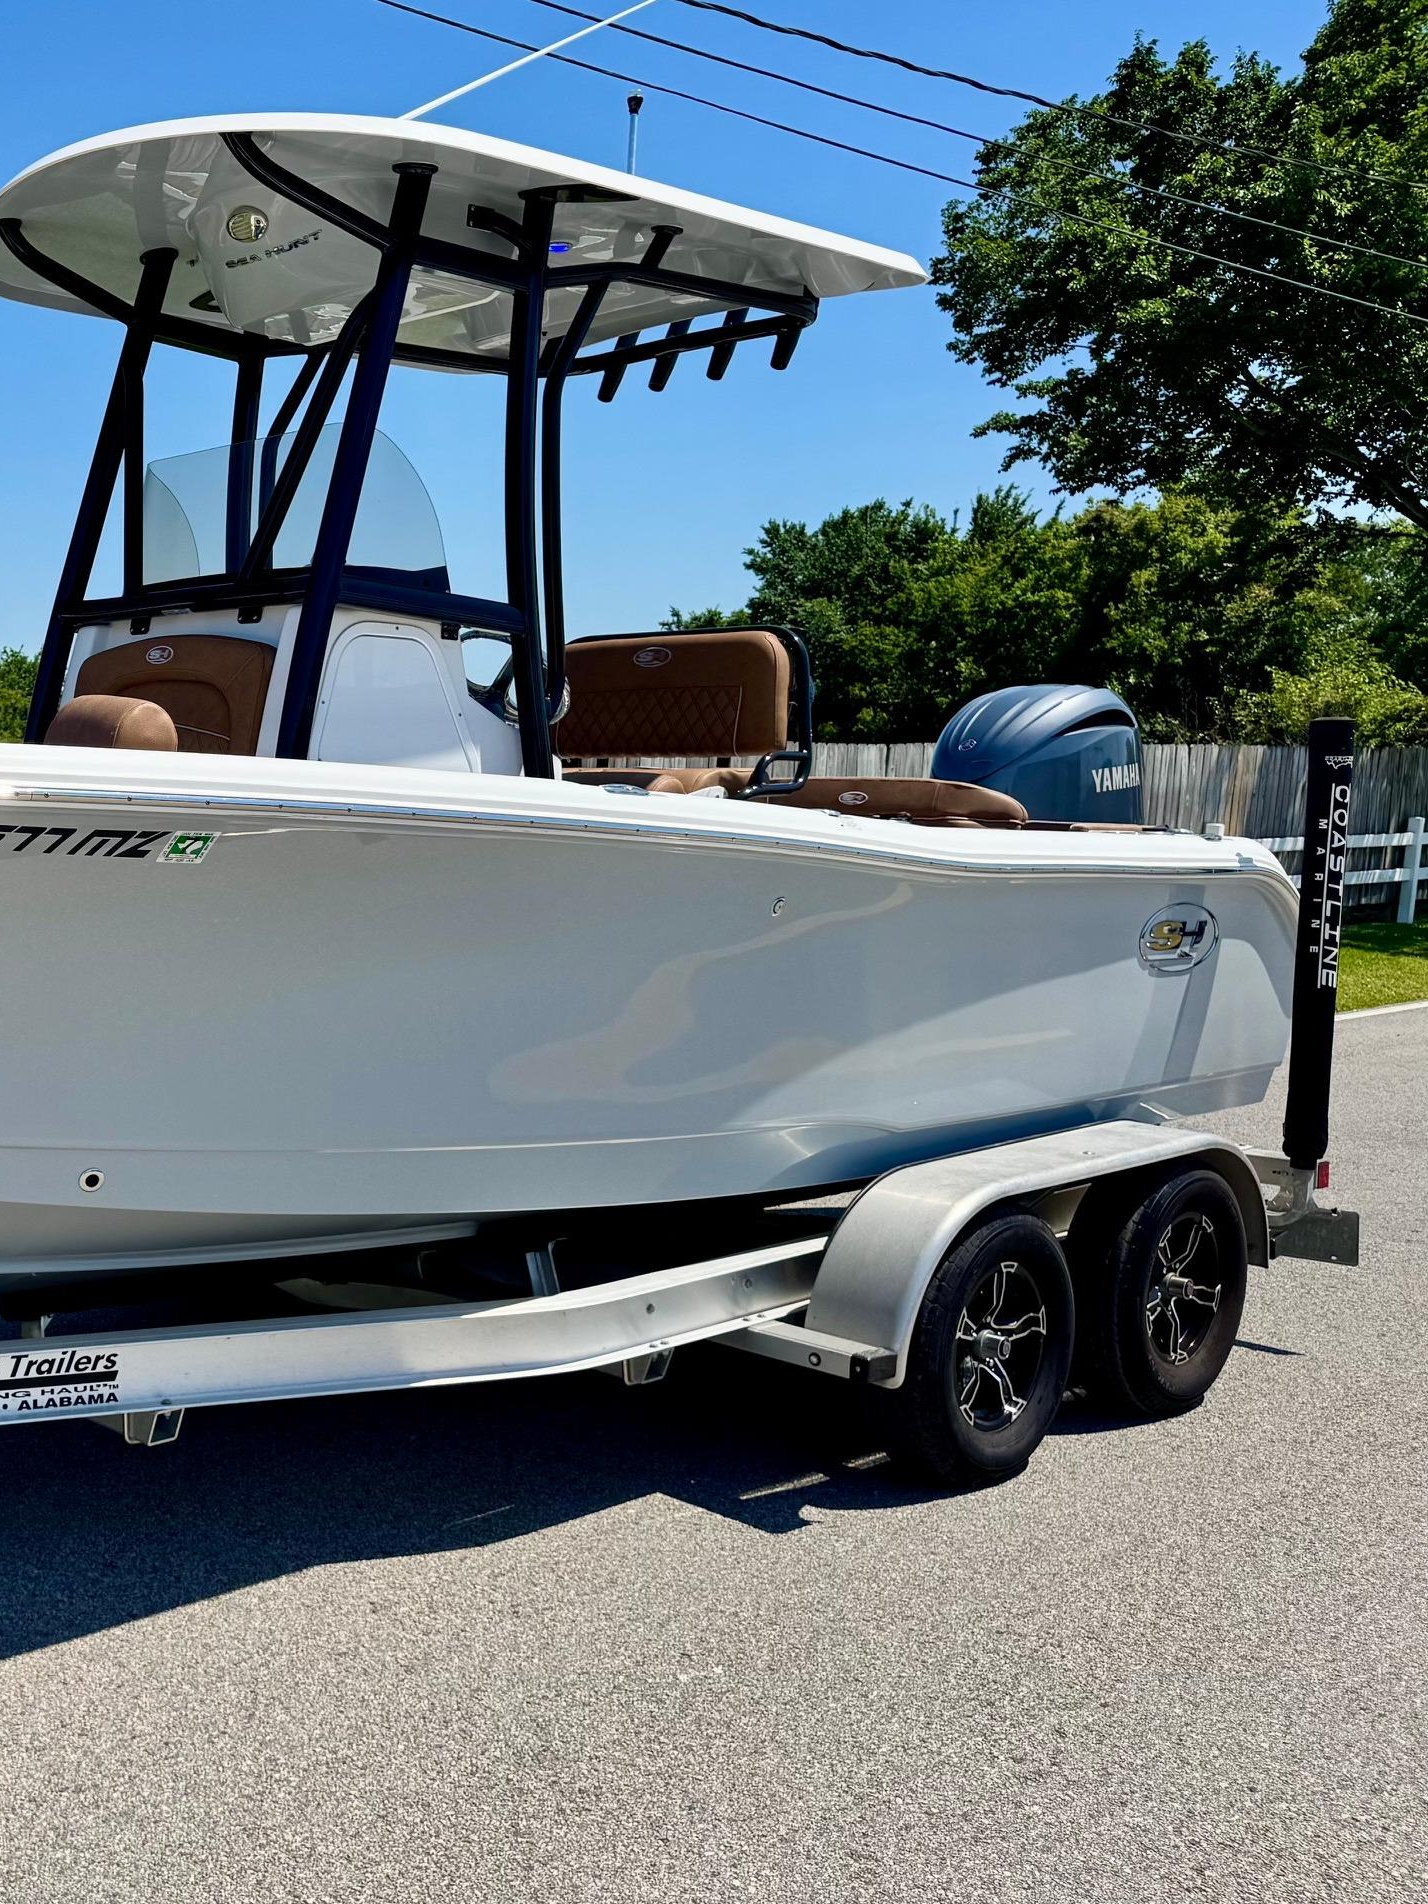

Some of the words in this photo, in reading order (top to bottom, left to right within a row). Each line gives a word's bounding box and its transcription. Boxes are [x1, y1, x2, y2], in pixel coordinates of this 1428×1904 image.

[225, 254, 262, 268] SEA
[264, 229, 323, 258] HUNT
[1091, 762, 1141, 793] YAMAHA
[66, 829, 173, 858] MZ
[1309, 818, 1328, 953] MARINE
[1321, 785, 1350, 989] COASTLINE
[10, 1350, 119, 1378] Trailers
[18, 1392, 119, 1411] ALABAMA
